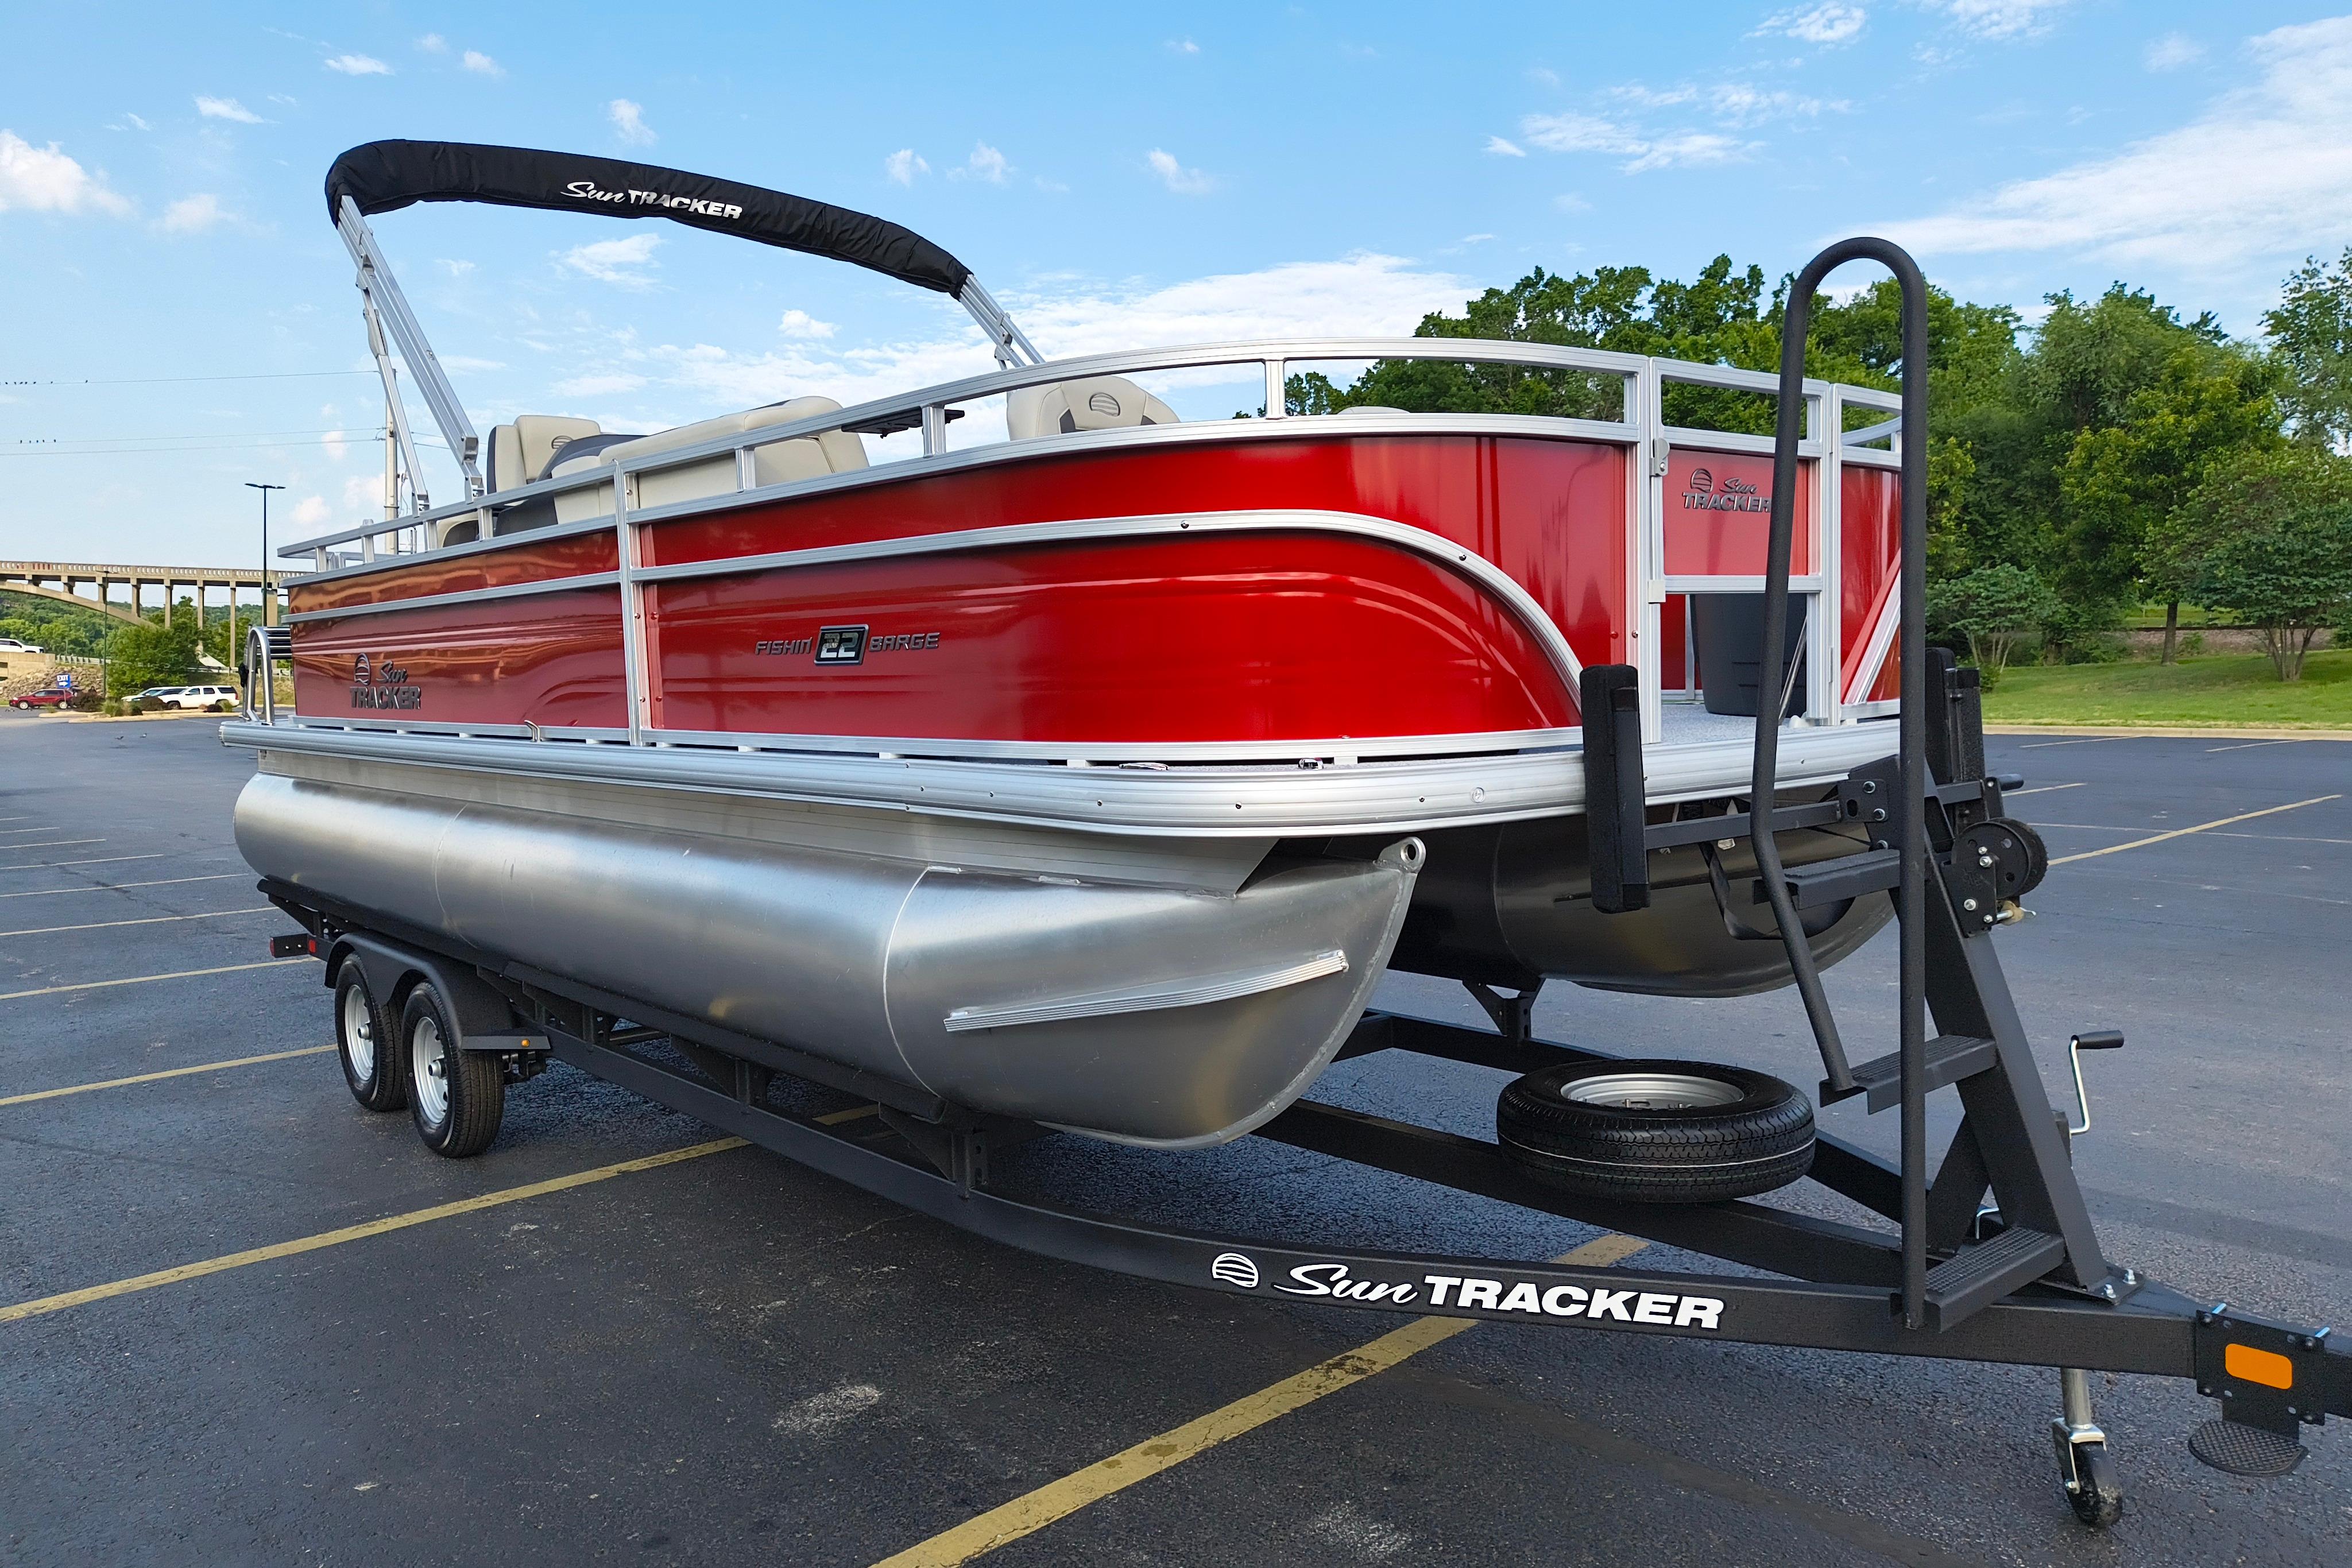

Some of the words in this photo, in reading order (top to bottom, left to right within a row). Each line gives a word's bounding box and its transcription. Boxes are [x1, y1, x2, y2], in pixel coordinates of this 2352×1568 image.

[560, 181, 626, 203] Sun
[628, 189, 743, 219] TRACKER
[1719, 478, 1758, 494] Sun
[819, 632, 860, 659] 22
[869, 632, 940, 652] BARGE
[376, 660, 408, 684] Sun
[350, 686, 421, 710] TRACKER
[1272, 1263, 1418, 1304] Sun
[1423, 1275, 1725, 1330] TRACKER
